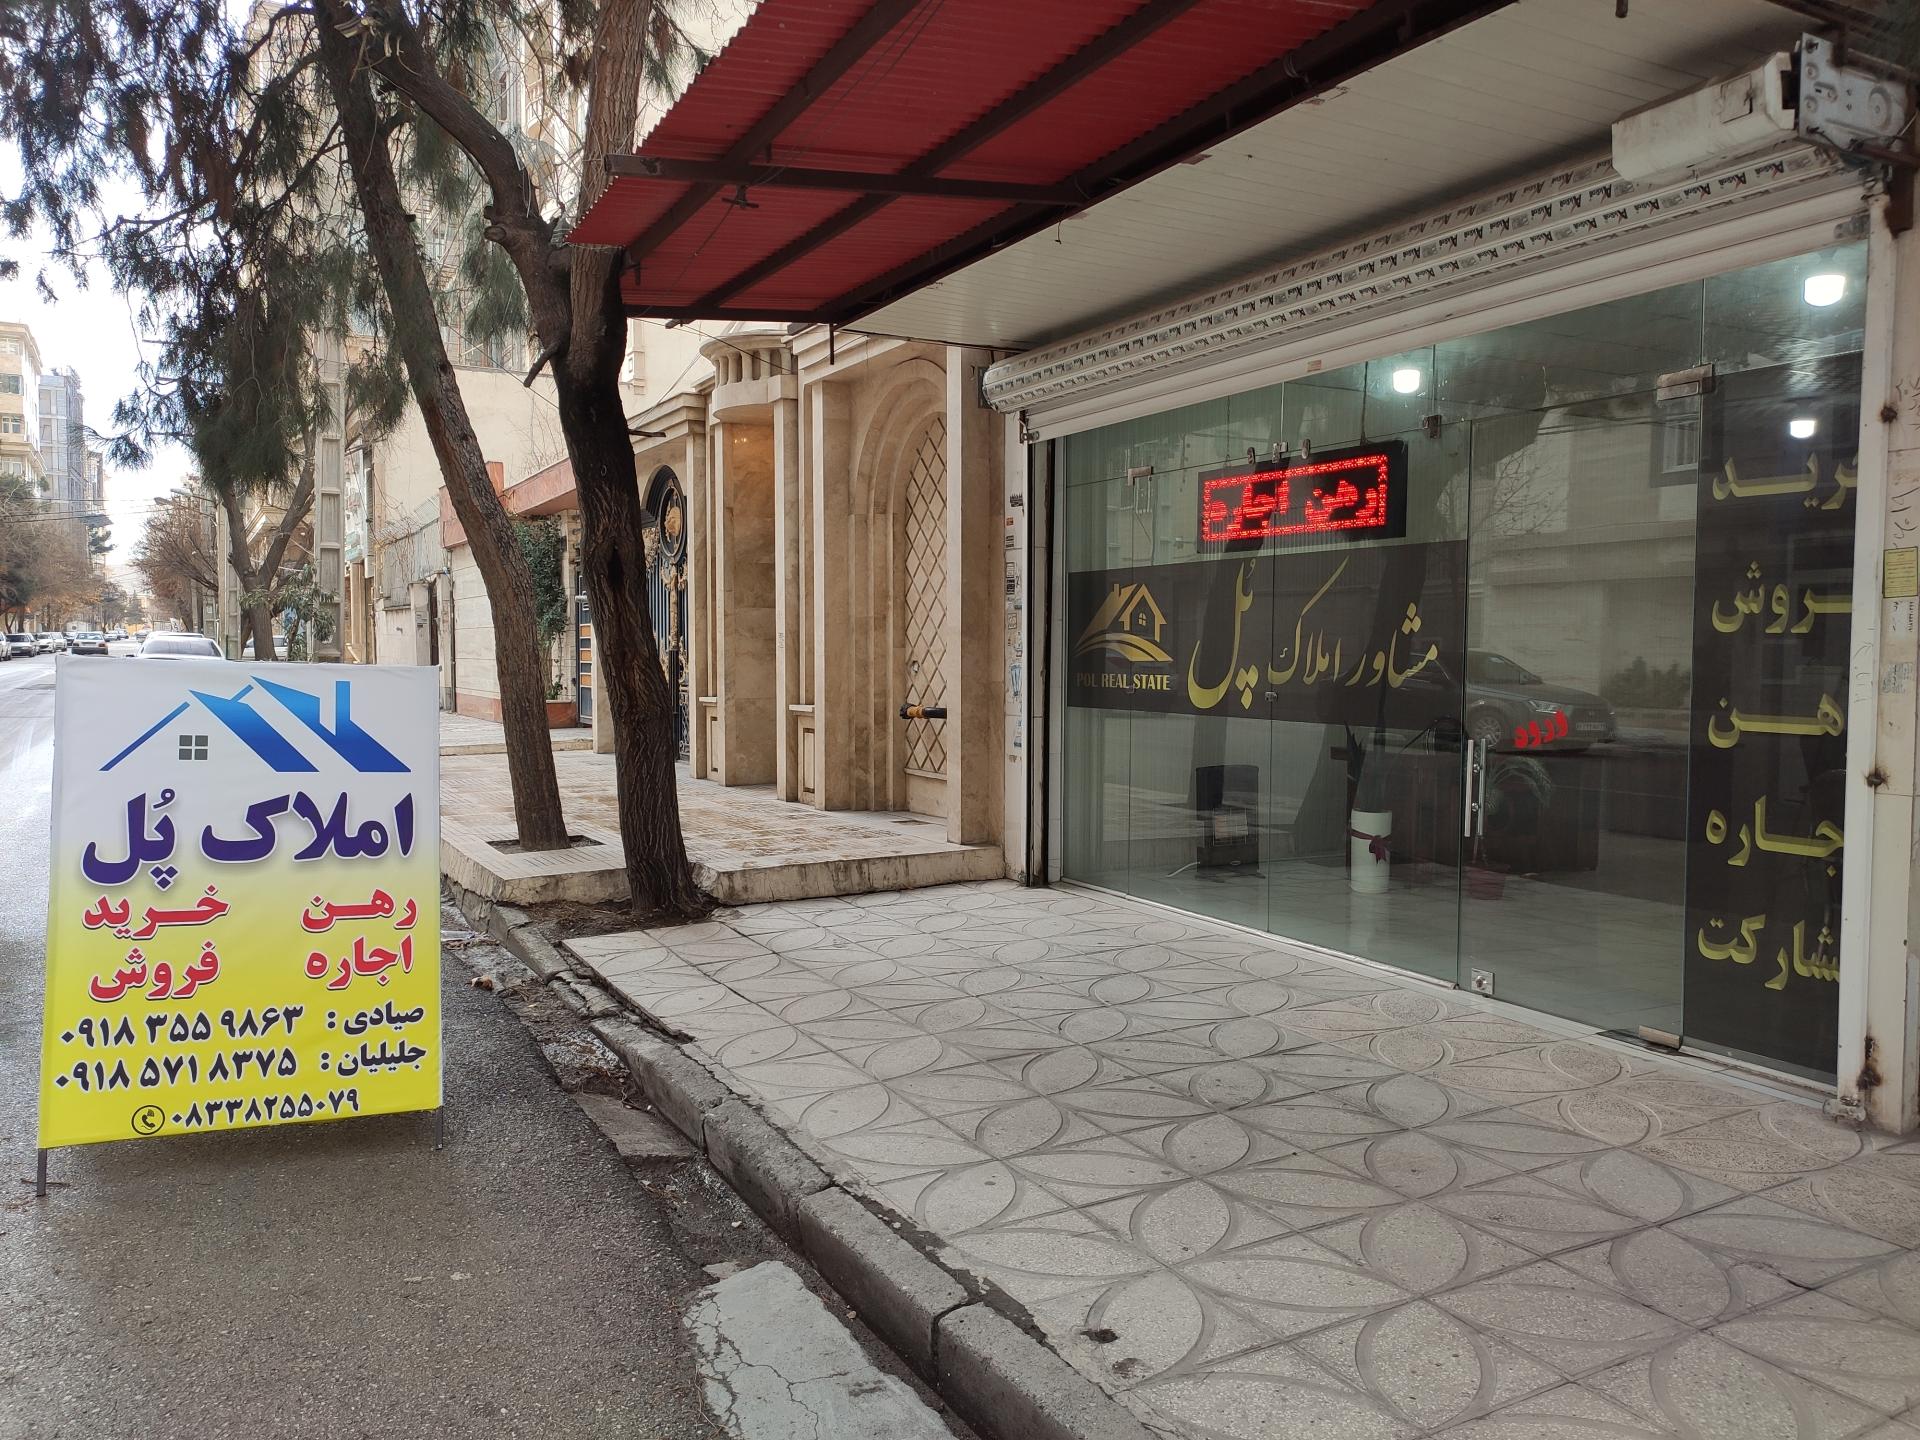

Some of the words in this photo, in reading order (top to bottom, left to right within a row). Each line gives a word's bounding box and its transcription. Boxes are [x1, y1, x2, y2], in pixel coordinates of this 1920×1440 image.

[1211, 480, 1289, 530] اجاره
[1305, 480, 1378, 524] رهن
[1713, 452, 1858, 510] رید
[1268, 555, 1349, 685] املاک
[1712, 560, 1852, 633] روش
[1345, 602, 1438, 688] مشاور
[1077, 673, 1099, 688] POL
[1101, 673, 1130, 689] REAL
[1133, 674, 1171, 690] STATE
[1708, 693, 1844, 748] هن
[200, 791, 414, 862] املاک
[1706, 795, 1844, 877] جاره
[82, 885, 230, 940] خرید
[300, 889, 418, 933] رهن
[89, 940, 221, 1001] فروش
[304, 935, 413, 990] اجاره
[1698, 914, 1839, 990] شارکت
[171, 1089, 359, 1128] ۰۸۳۳۸۲۵۵۰۷۹
